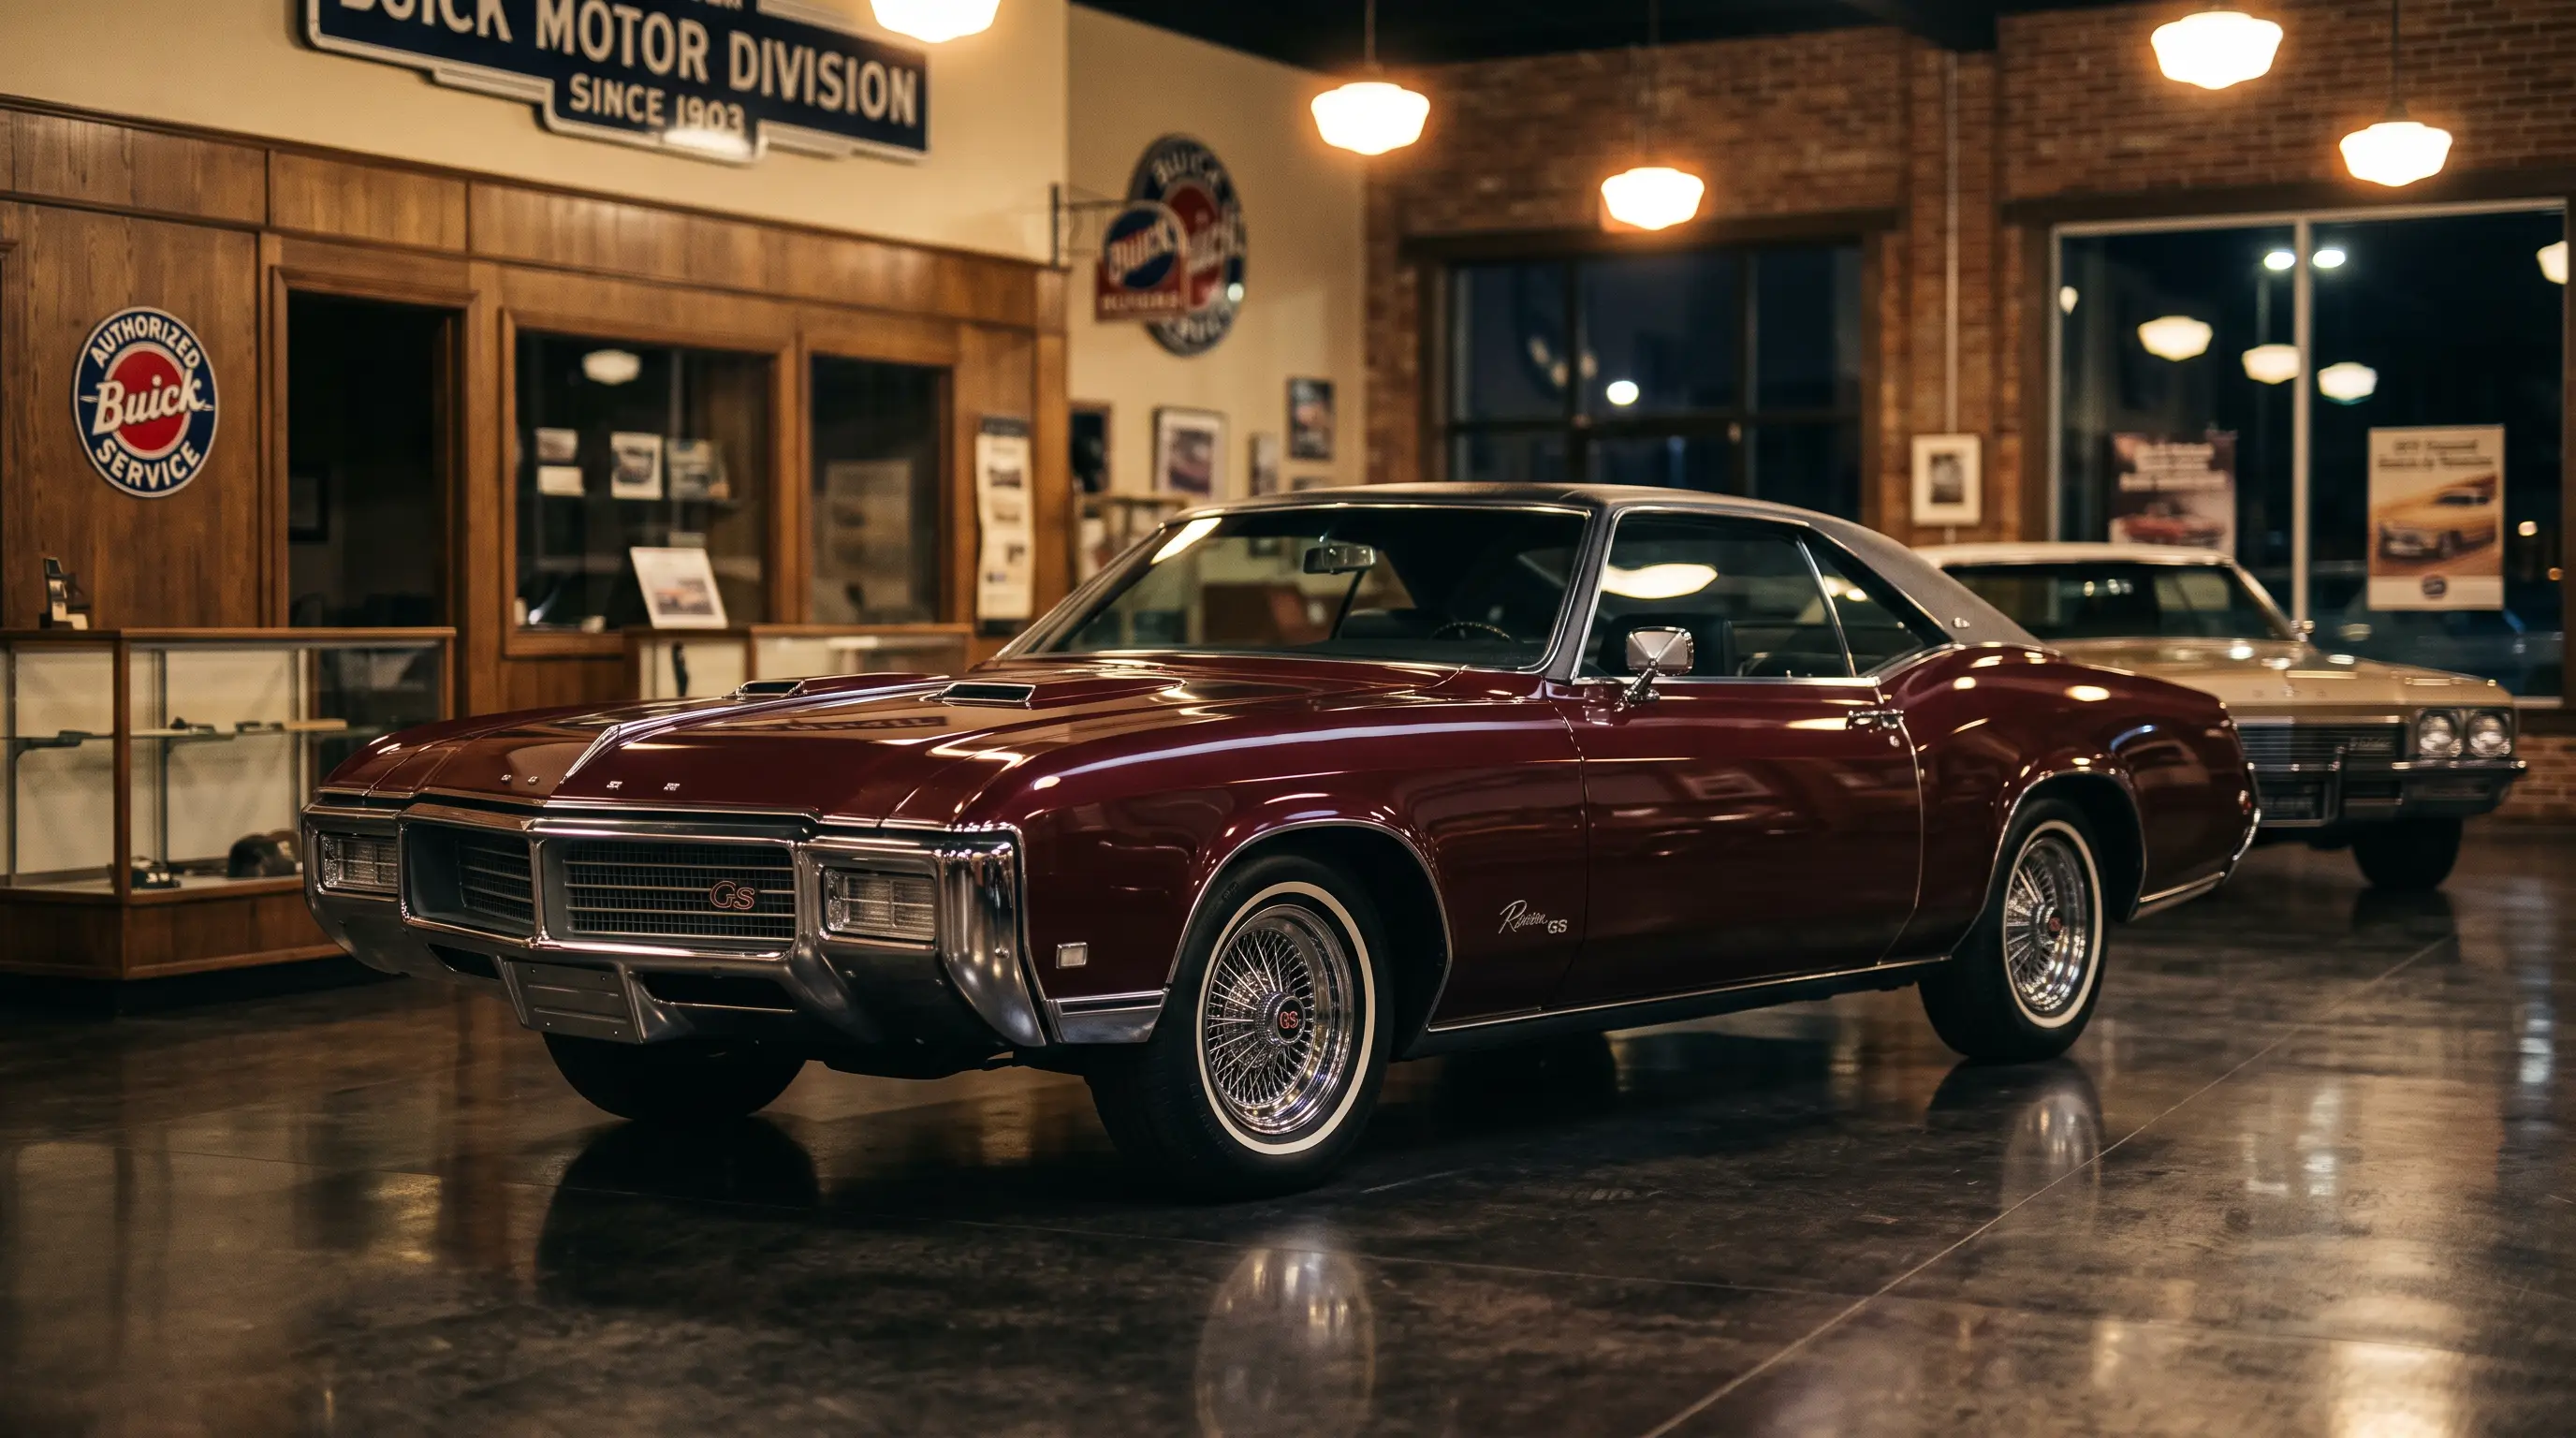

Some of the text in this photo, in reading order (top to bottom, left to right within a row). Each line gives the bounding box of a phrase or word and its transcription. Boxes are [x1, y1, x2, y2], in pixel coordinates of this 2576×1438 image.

[535, 0, 710, 84] MOTOR
[728, 29, 917, 128] DIVISION
[568, 72, 746, 137] SINCE 1903
[90, 315, 201, 370] AUTHORIZED
[92, 368, 203, 435] Buick
[96, 438, 201, 490] SERVICE
[1547, 918, 1568, 934] GS
